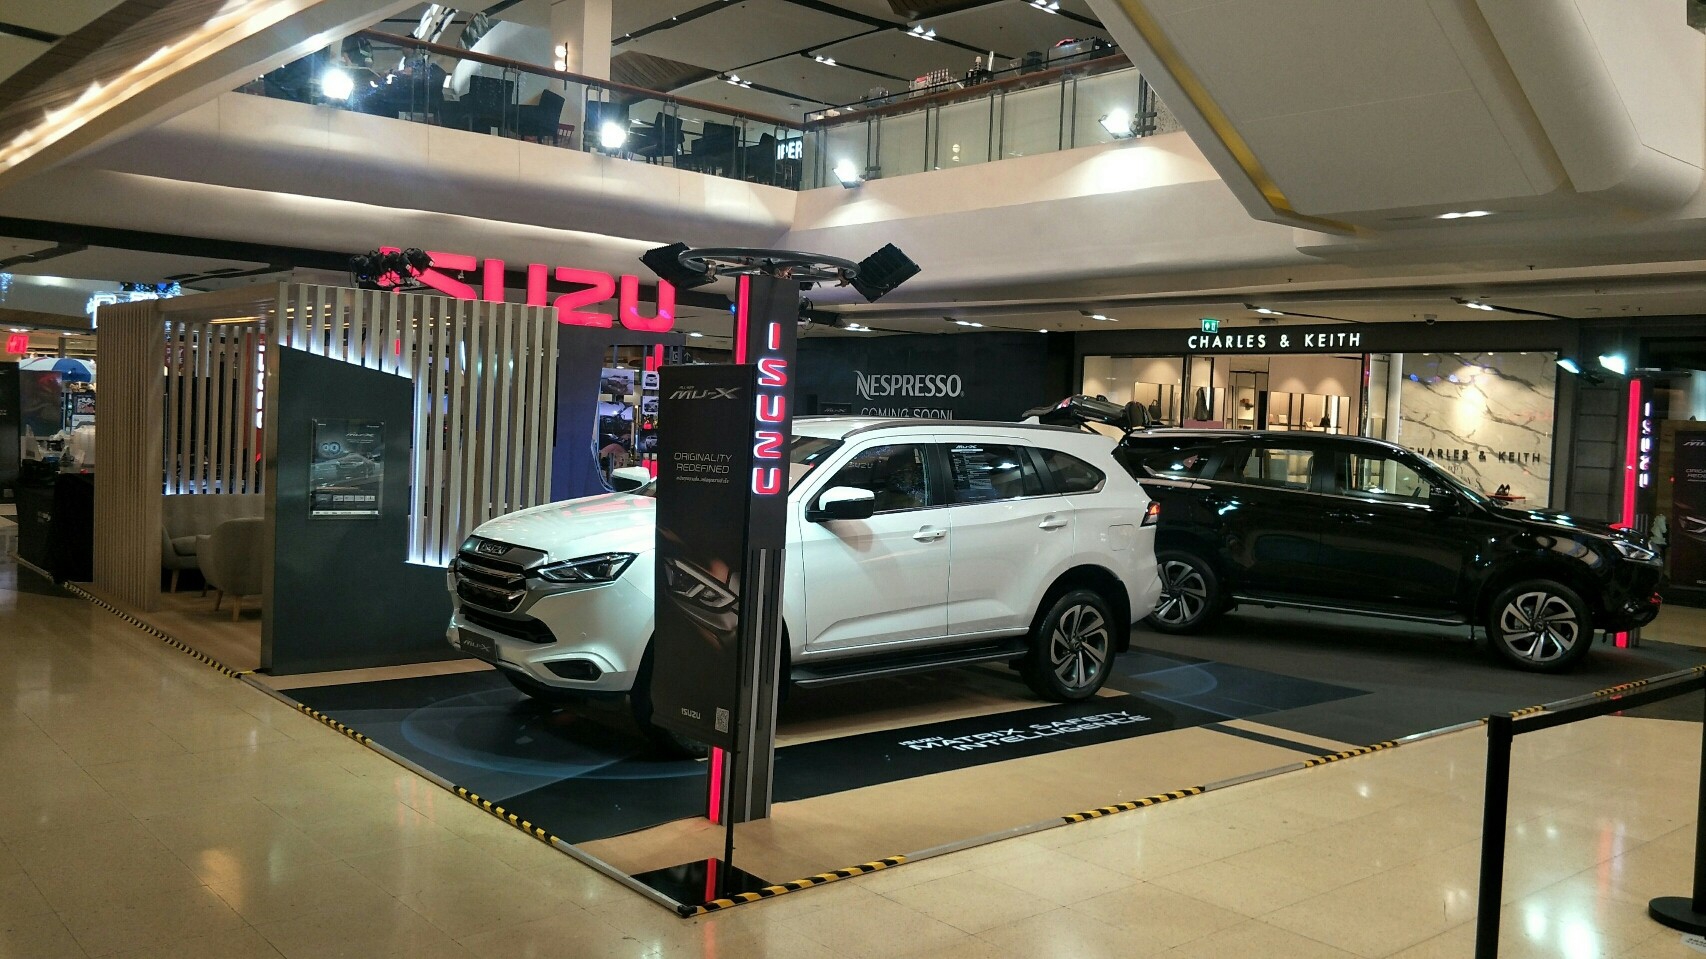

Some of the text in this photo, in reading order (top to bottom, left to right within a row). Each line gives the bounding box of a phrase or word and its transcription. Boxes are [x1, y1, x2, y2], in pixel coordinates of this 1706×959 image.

[1187, 332, 1361, 349] CHARLES & KEITH
[853, 370, 962, 401] NESPRESSO
[752, 322, 788, 495] ISUZU
[674, 452, 733, 462] ORIGINALITY
[1478, 450, 1487, 461] &
[1498, 451, 1541, 463] KEITH
[676, 463, 730, 474] REDEFINED
[681, 707, 701, 720] ISUZU
[908, 710, 1131, 751] MATRIX SAFETY
[951, 714, 1152, 752] INTELLIGENCE
[899, 736, 944, 747] ISUZU
